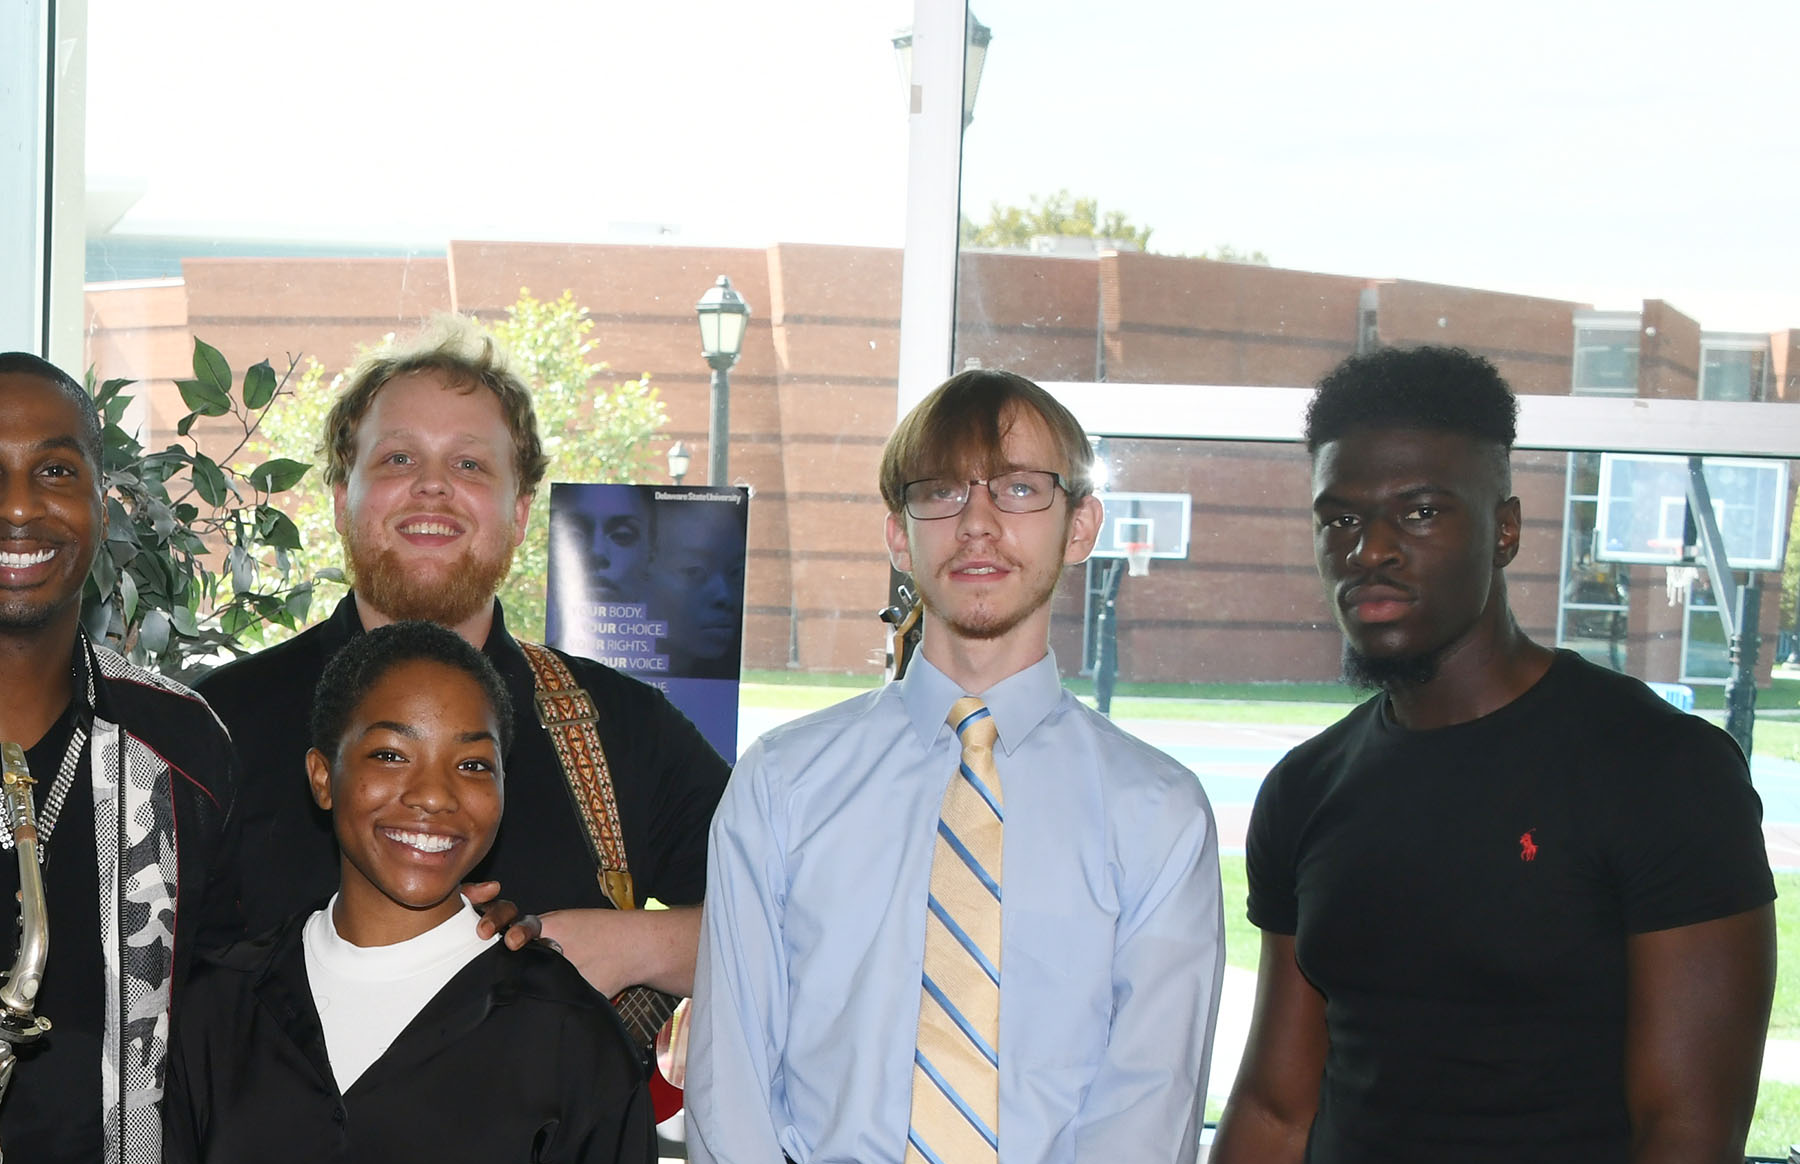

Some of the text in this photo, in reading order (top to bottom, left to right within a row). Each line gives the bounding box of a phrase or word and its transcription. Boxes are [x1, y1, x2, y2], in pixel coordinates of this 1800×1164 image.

[609, 606, 642, 618] BODY.
[618, 623, 665, 636] CHOICE.
[607, 640, 650, 652] RIGHTS.
[599, 657, 666, 670] OUR VOICE.
